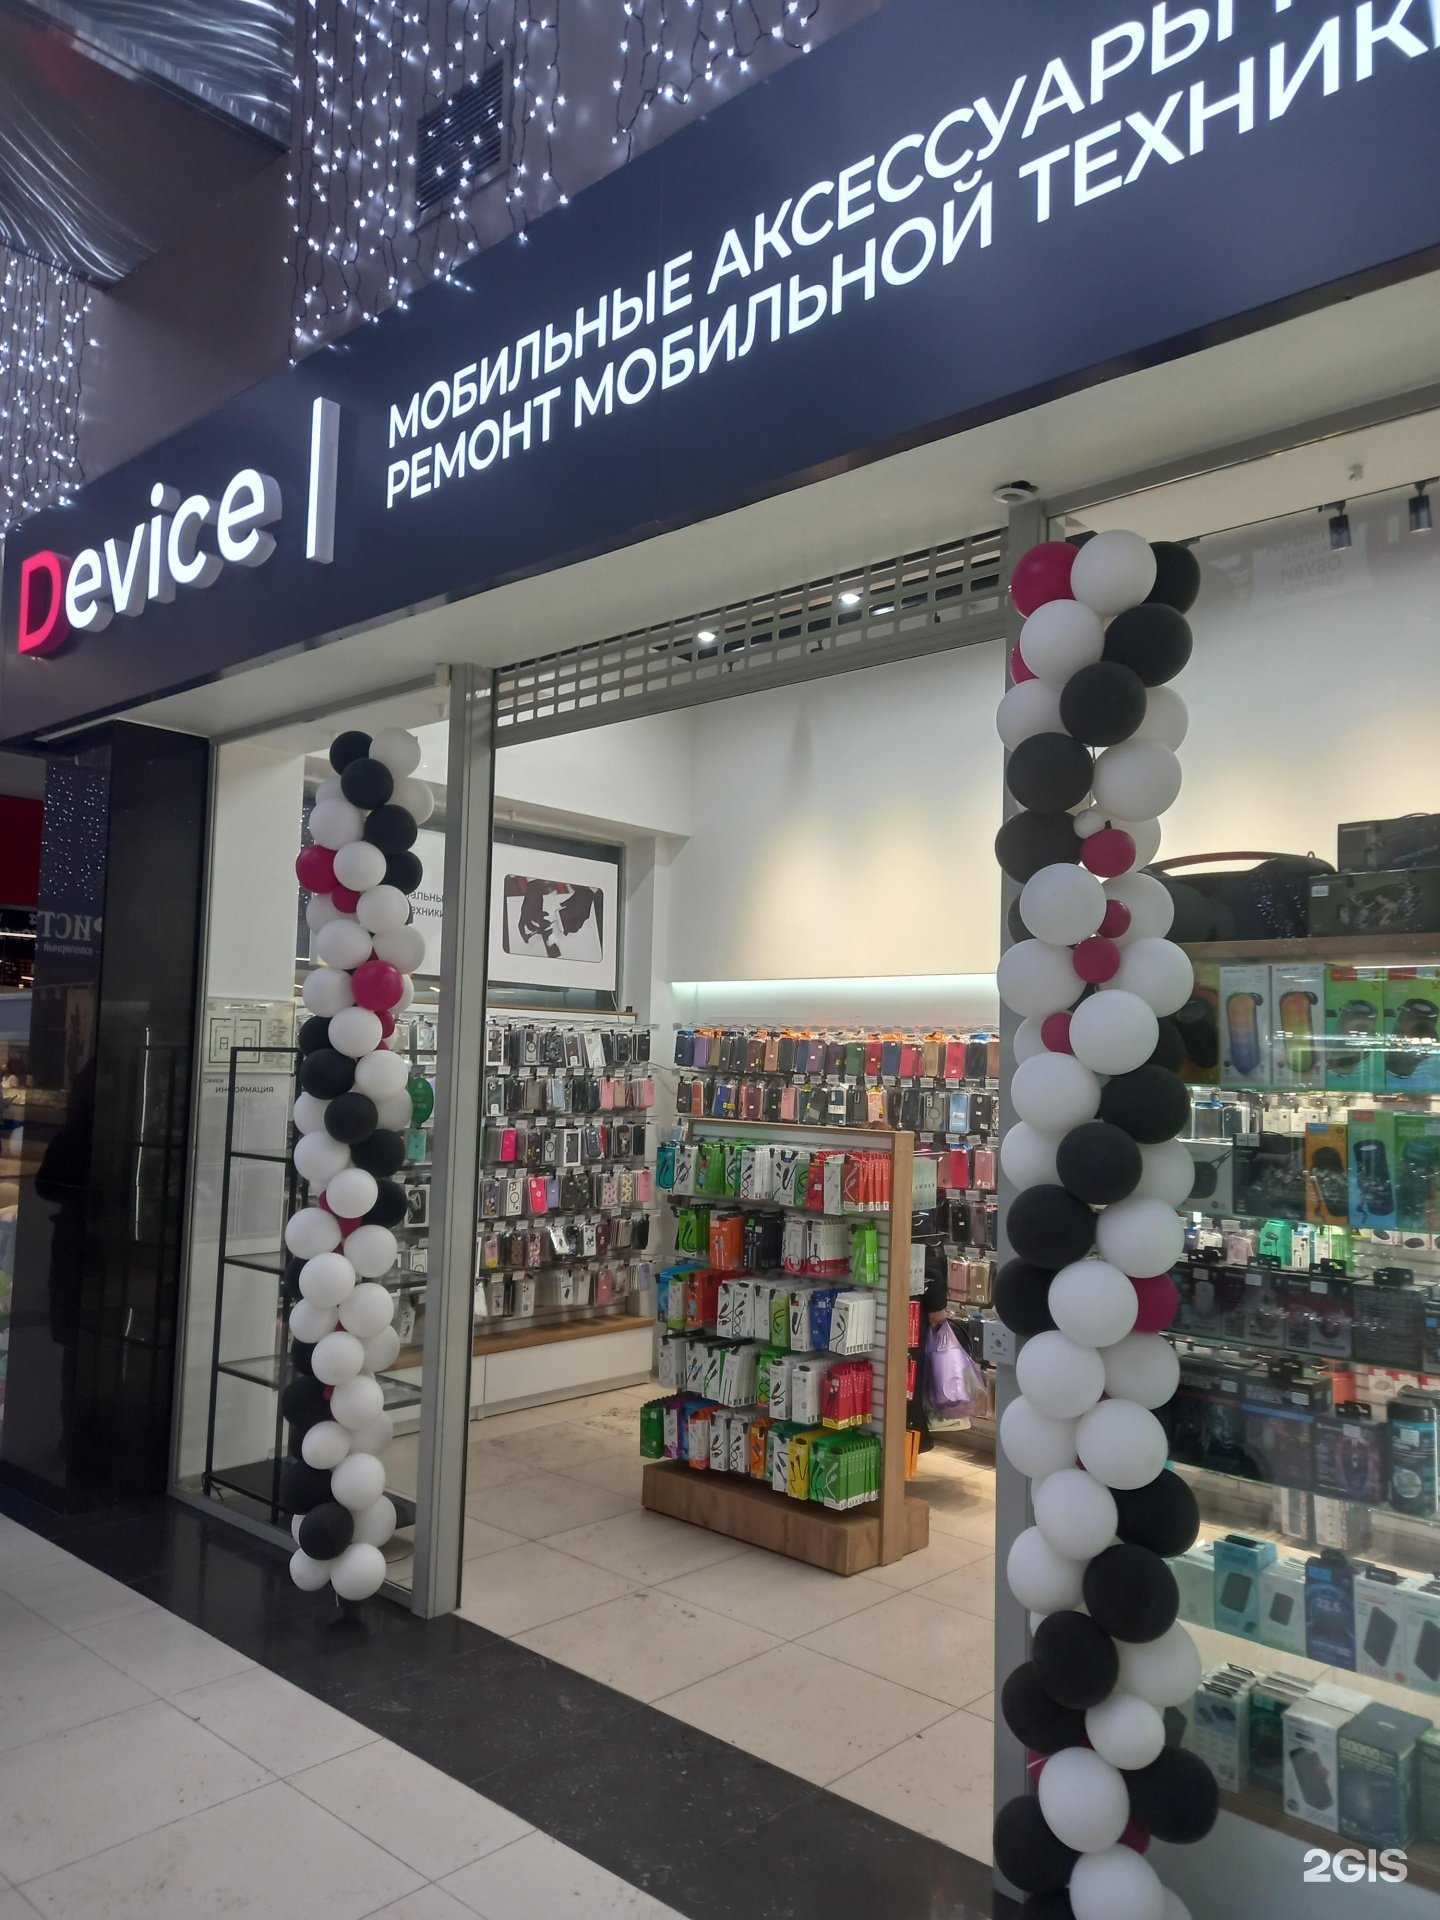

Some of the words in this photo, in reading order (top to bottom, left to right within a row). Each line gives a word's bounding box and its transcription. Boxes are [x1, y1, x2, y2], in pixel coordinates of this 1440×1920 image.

[387, 381, 561, 509] РЕМОНТ
[574, 169, 993, 428] МОБИЛЬНОЙ
[1019, 0, 1440, 223] ТЕХНИК
[390, 252, 693, 449] МОБИЛЬНЫЕ
[707, 0, 1233, 294] АКСЕССУАРЫ
[17, 469, 265, 654] Device
[215, 1085, 275, 1095] ИНОРМАЦИЯ
